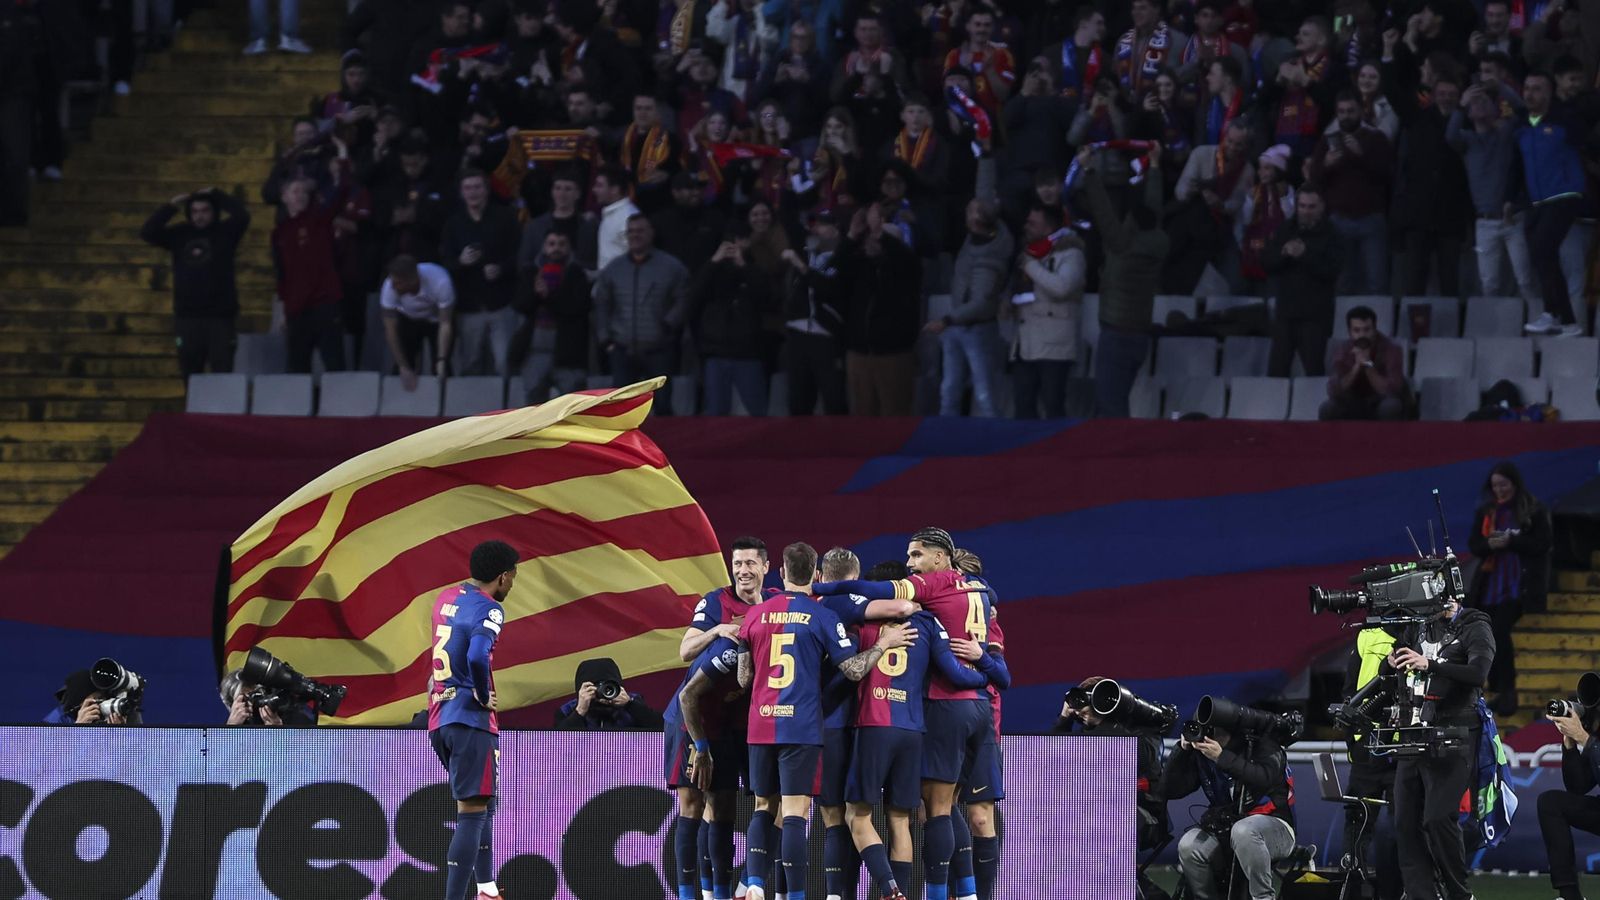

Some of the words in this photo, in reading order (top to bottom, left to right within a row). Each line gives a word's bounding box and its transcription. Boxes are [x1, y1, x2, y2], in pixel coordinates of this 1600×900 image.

[965, 591, 987, 642] 4
[433, 624, 452, 681] 3
[768, 633, 795, 689] 5
